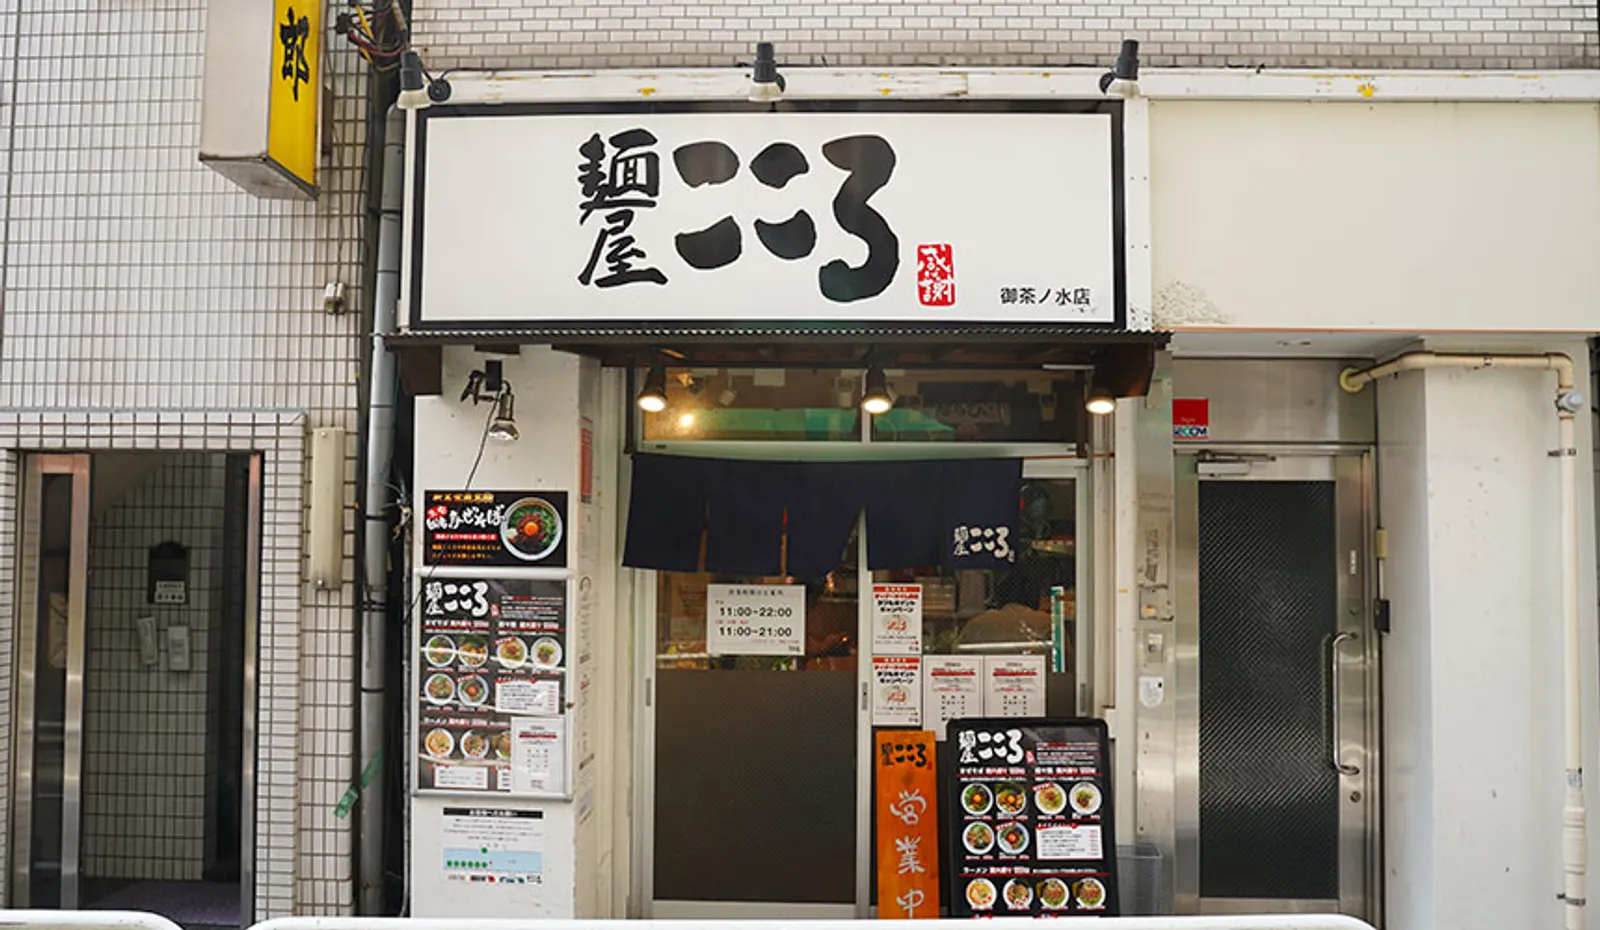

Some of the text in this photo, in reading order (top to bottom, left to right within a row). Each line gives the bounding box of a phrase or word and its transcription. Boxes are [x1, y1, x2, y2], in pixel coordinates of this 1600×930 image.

[672, 134, 900, 302] こころ
[1000, 287, 1091, 305] 御茶ノ水店
[969, 526, 1009, 558] こころ
[444, 581, 489, 617] こころ
[895, 743, 927, 768] こころ
[977, 729, 1024, 764] こころ
[889, 788, 927, 919] 営業中
